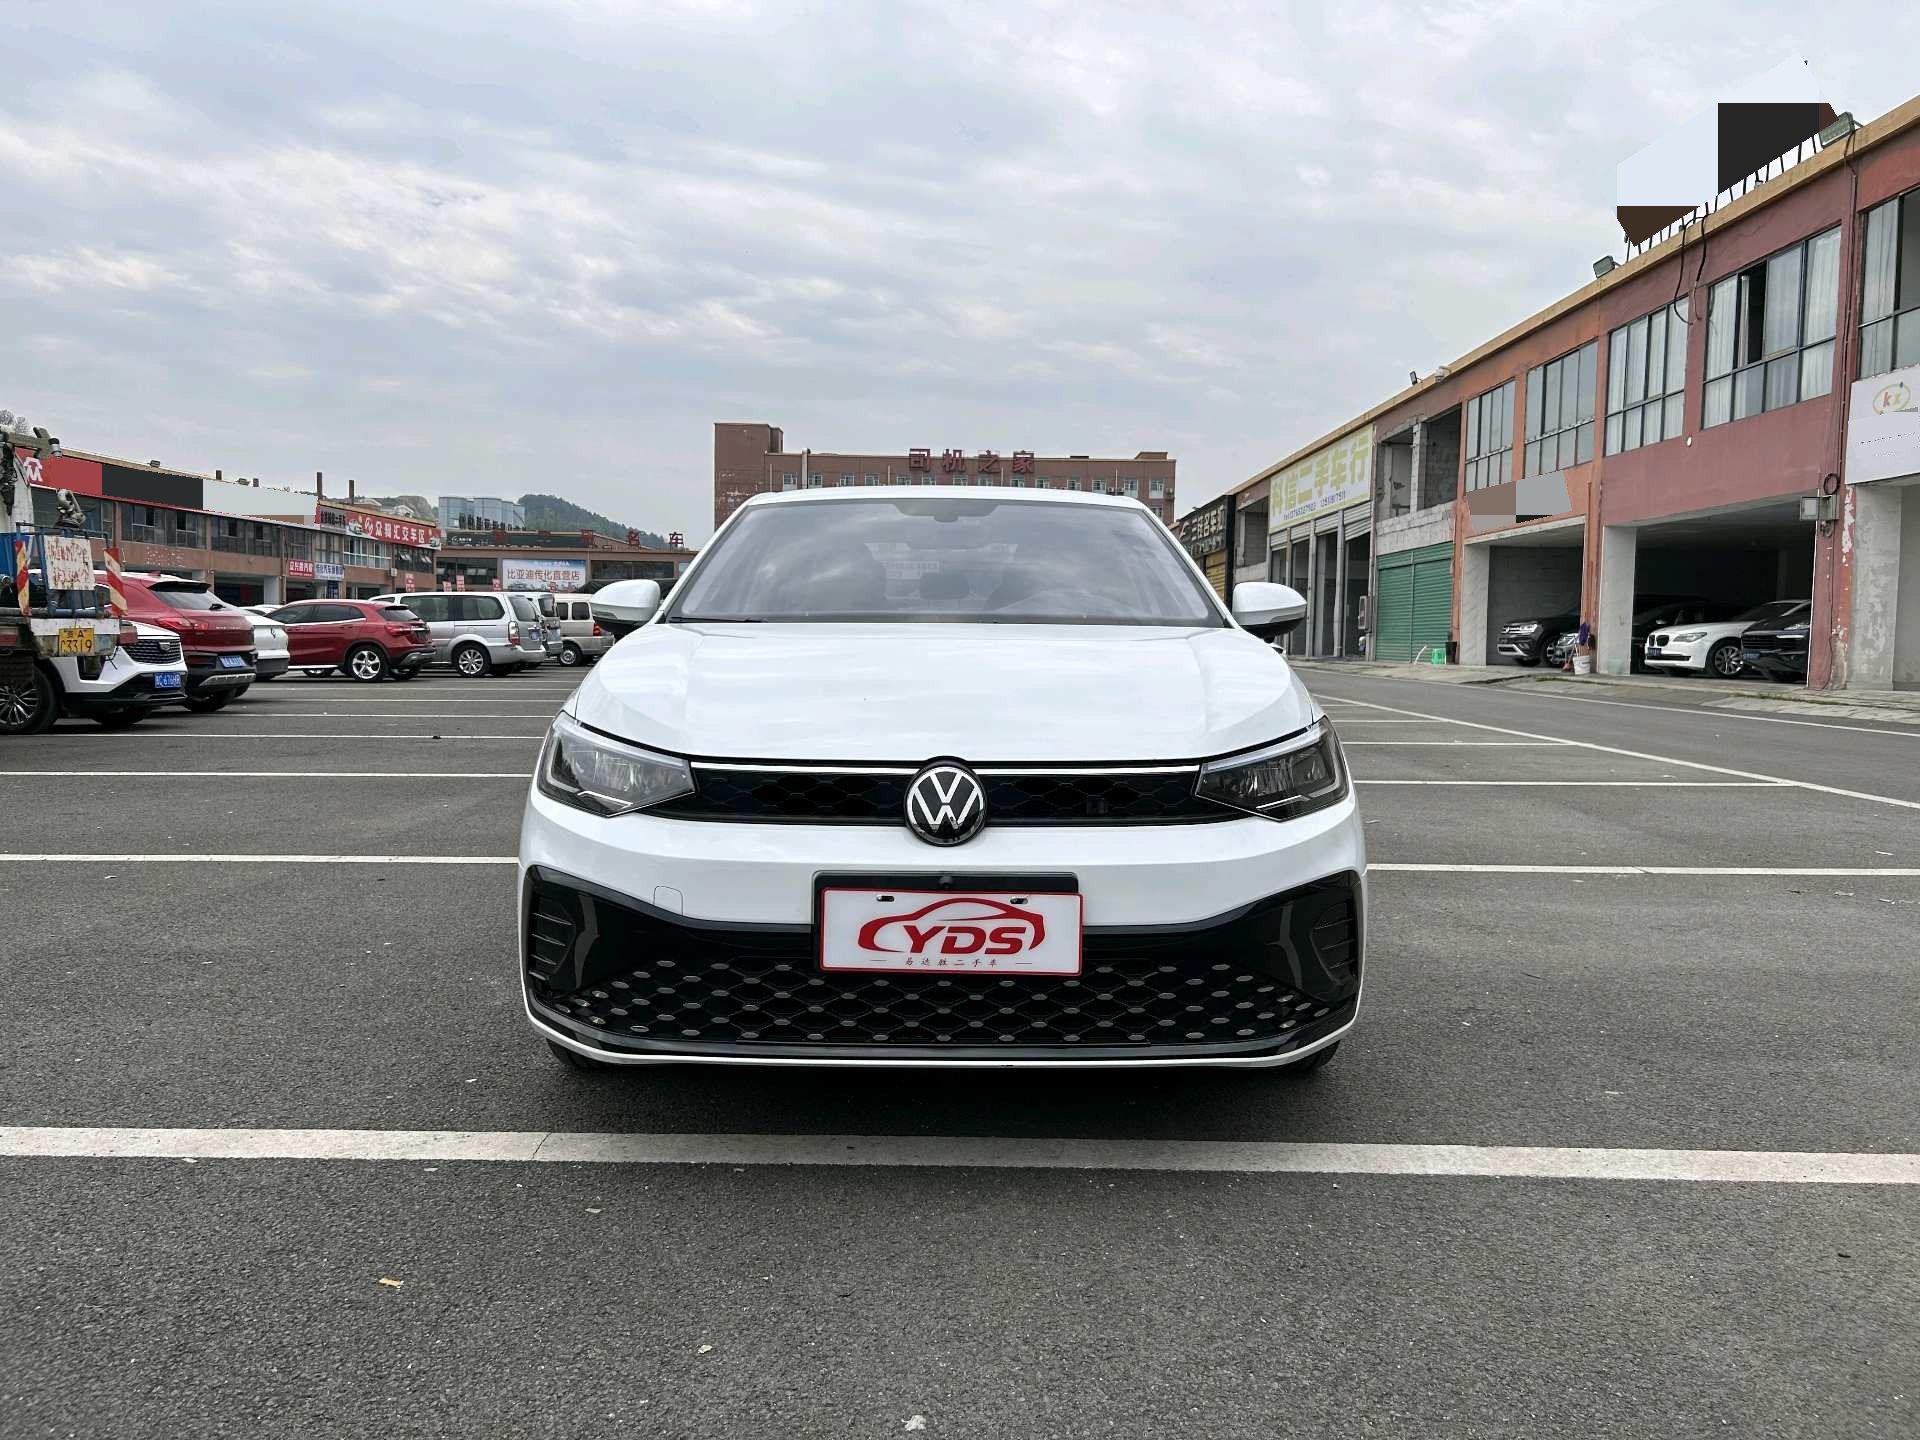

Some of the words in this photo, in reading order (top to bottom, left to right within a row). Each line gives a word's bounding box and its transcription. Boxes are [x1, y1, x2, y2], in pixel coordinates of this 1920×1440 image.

[908, 448, 1035, 473] 司机之家
[506, 568, 581, 581] 比亚迪传化直营店
[903, 924, 1027, 955] YDS
